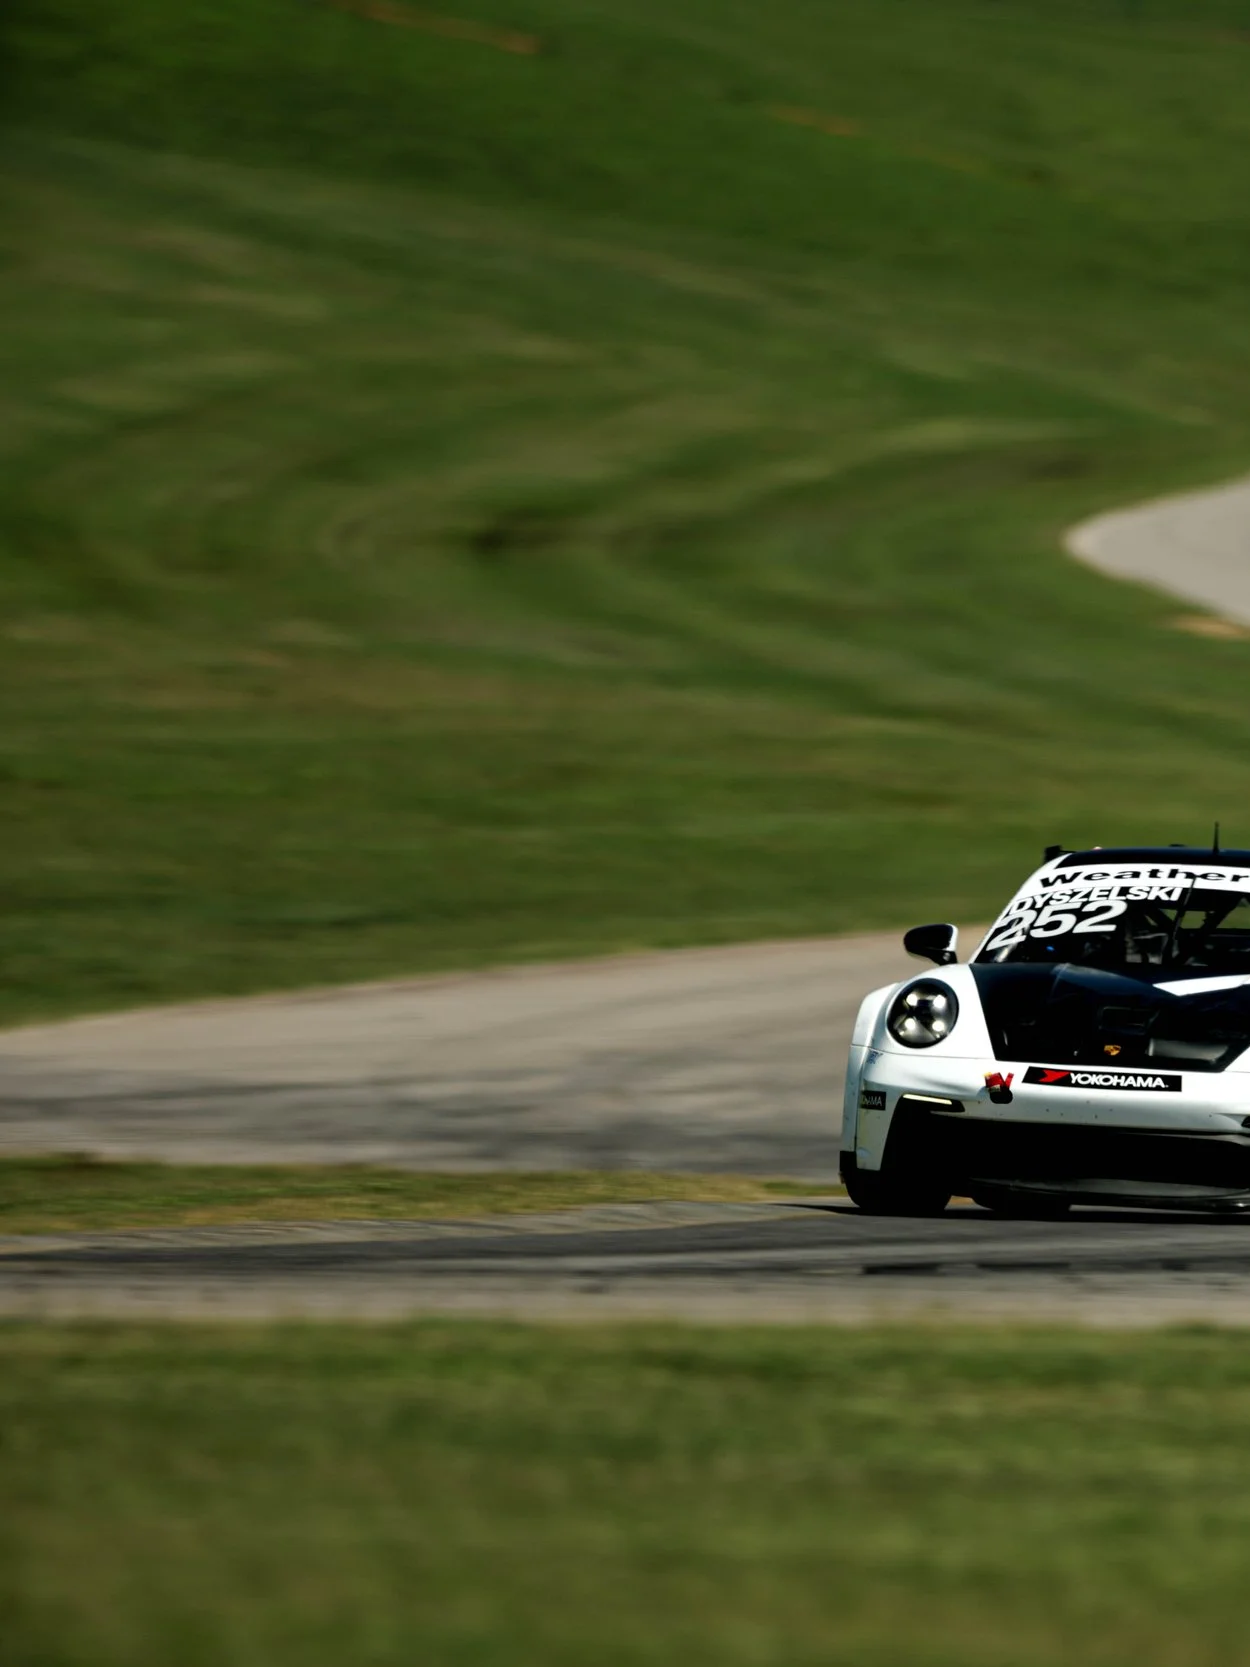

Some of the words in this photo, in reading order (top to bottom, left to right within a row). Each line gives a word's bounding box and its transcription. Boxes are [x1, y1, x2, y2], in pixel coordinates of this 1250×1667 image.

[1009, 886, 1182, 915] DYSZELSKI
[986, 900, 1128, 951] 252
[1070, 1072, 1166, 1088] YOKOHAMA
